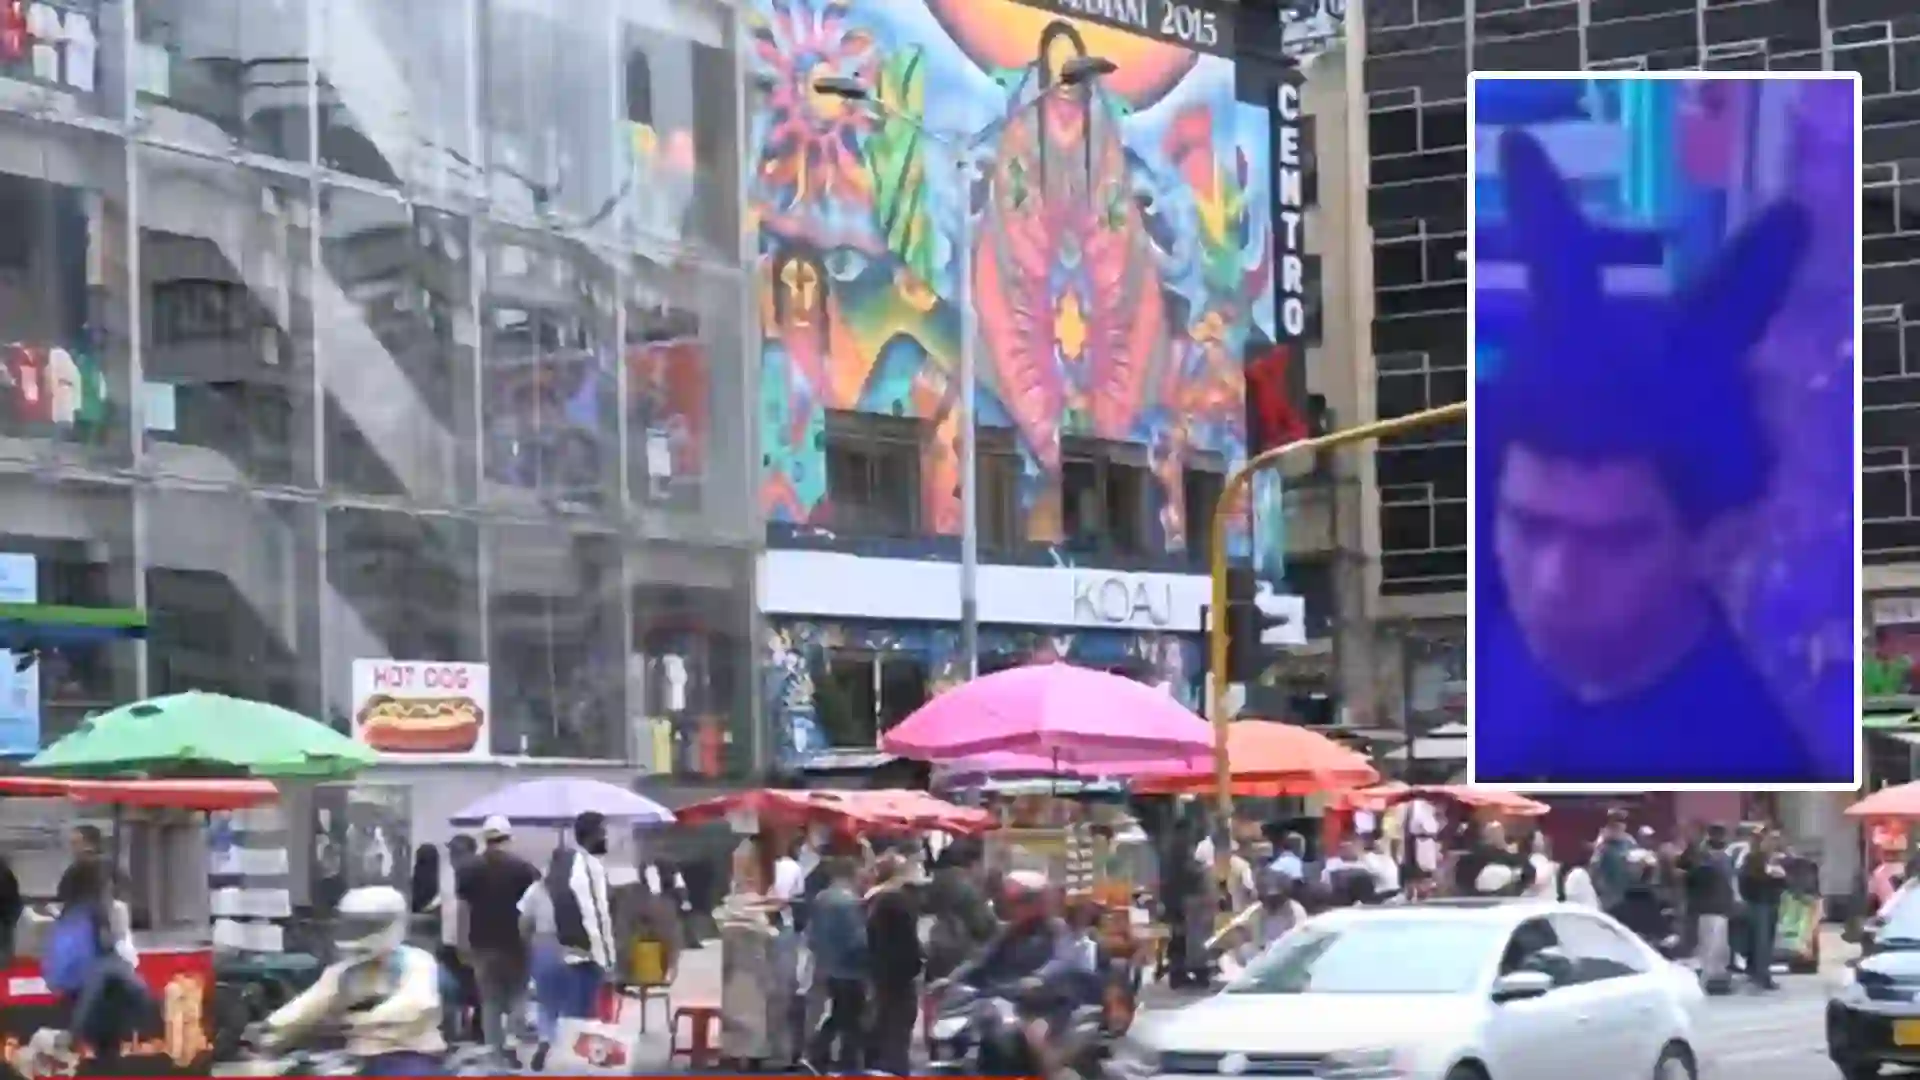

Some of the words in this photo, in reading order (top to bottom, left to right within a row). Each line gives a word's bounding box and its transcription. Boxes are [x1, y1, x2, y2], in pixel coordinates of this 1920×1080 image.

[1161, 1, 1218, 47] 2015
[1277, 83, 1304, 336] CENTRO
[1073, 577, 1172, 626] KOAJ
[373, 665, 415, 689] HOT
[423, 666, 469, 690] DOG
